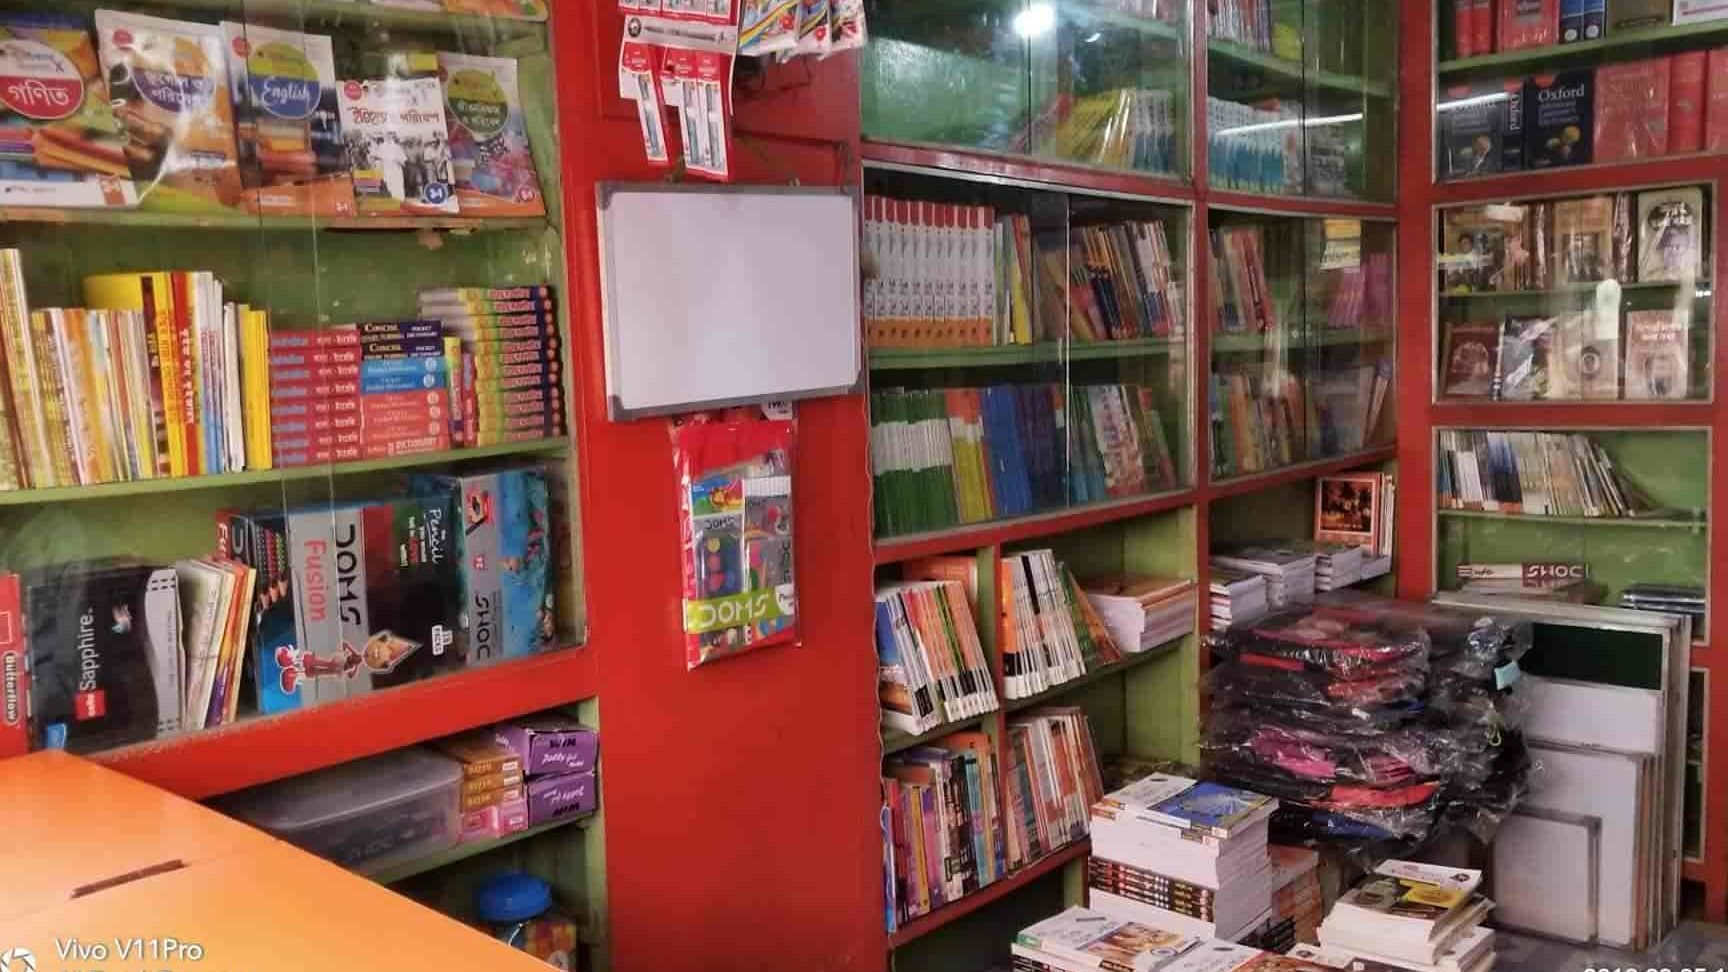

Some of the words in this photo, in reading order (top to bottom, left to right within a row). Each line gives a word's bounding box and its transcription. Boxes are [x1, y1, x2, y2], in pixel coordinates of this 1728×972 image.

[8, 79, 70, 106] গণিত
[263, 76, 310, 105] English
[1538, 84, 1585, 101] Oxford
[429, 507, 444, 564] Pencil
[704, 516, 736, 531] DOMS
[304, 540, 329, 623] Fusion
[335, 523, 361, 626] DOMS
[475, 592, 490, 660] DOMS
[700, 594, 769, 628] DOMS
